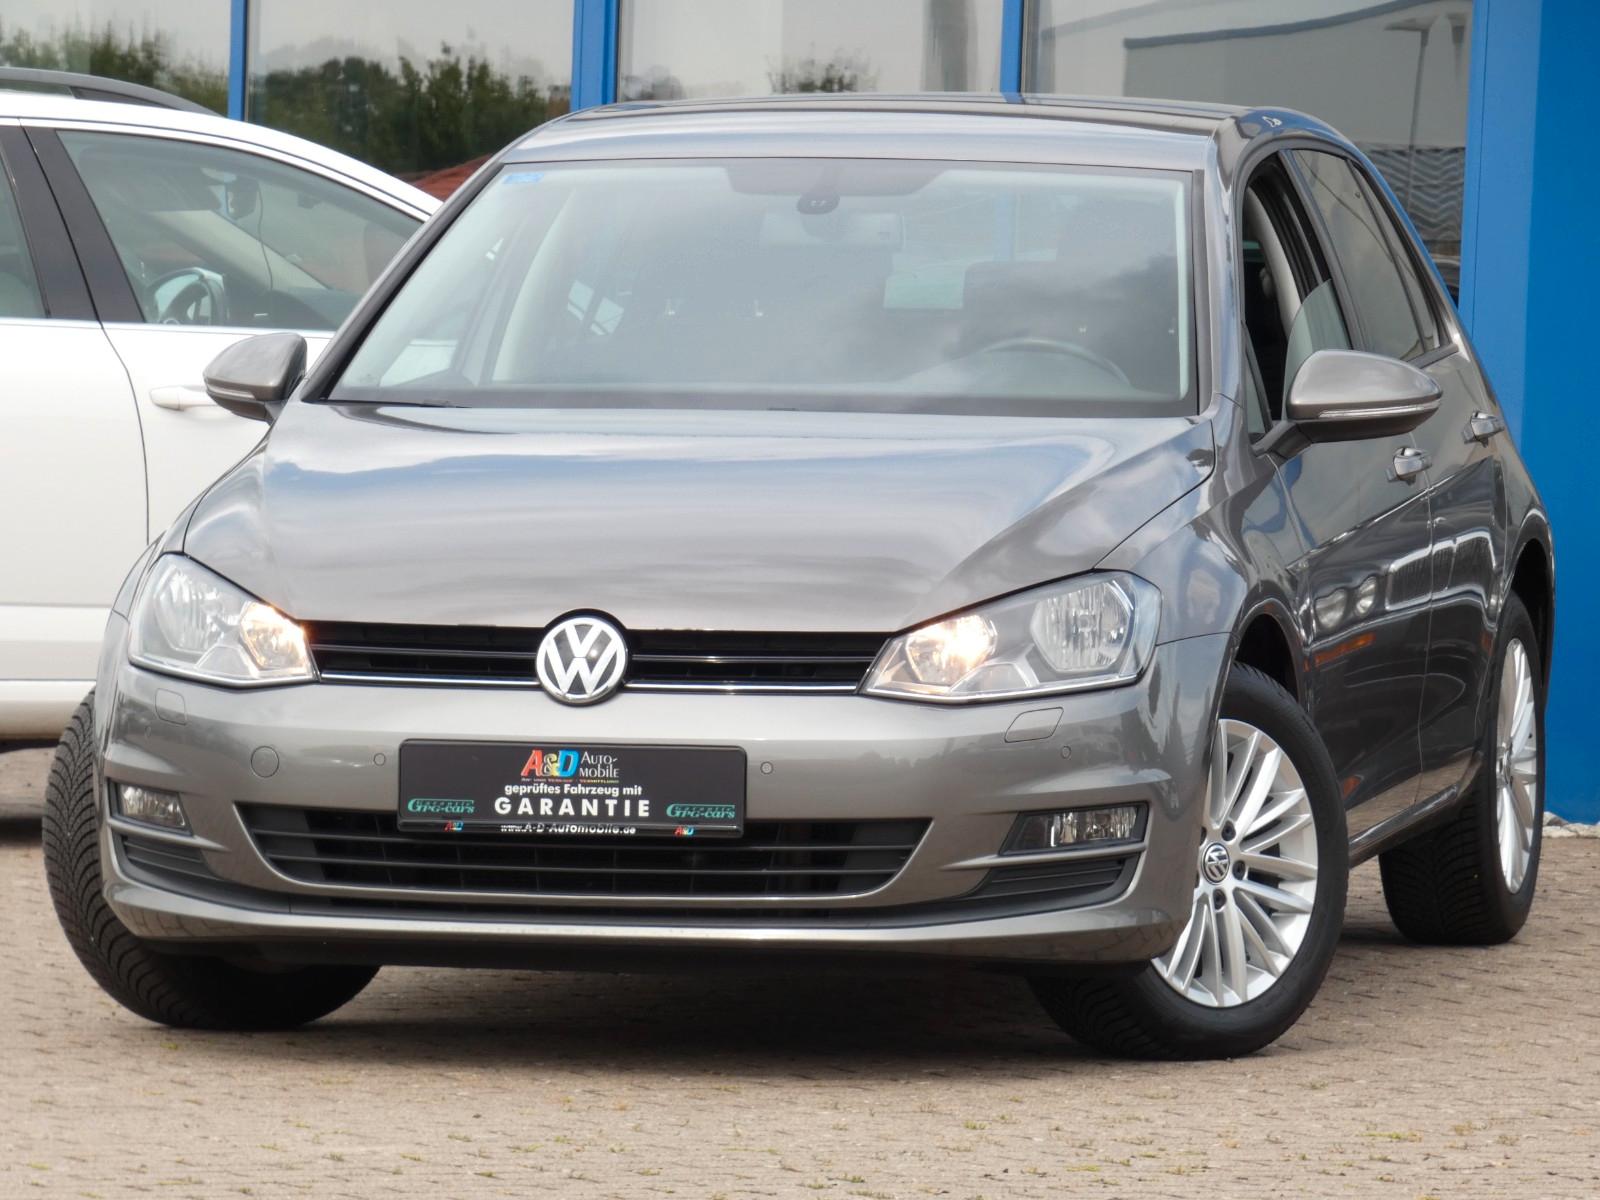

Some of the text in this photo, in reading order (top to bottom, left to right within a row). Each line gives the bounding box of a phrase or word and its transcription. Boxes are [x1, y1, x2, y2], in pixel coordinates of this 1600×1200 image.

[536, 616, 626, 703] VW
[520, 749, 580, 777] A&D
[504, 783, 643, 797] geprüftes Fahrzeug mit
[494, 796, 650, 817] GARANTIE
